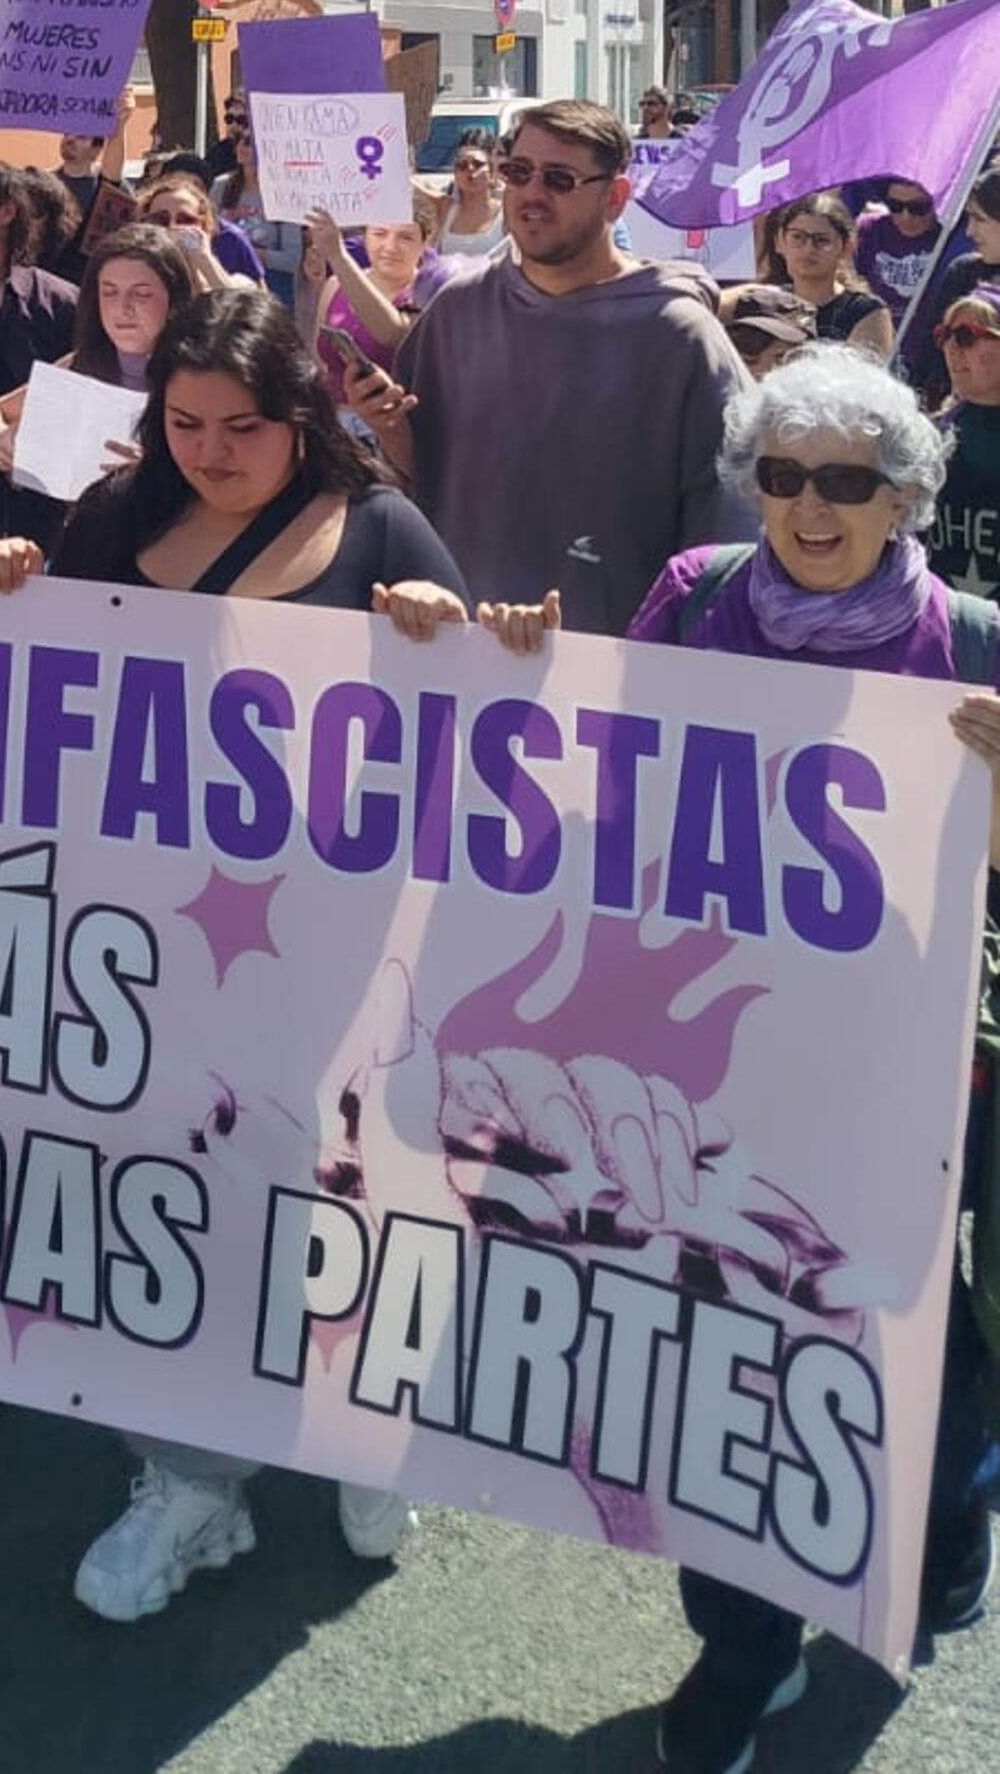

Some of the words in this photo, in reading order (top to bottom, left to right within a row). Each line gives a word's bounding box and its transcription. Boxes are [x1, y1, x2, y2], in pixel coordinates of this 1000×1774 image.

[3, 19, 100, 50] MUJERES
[29, 52, 57, 74] NI
[62, 55, 113, 80] SIN
[252, 1184, 885, 1588] PARTES
